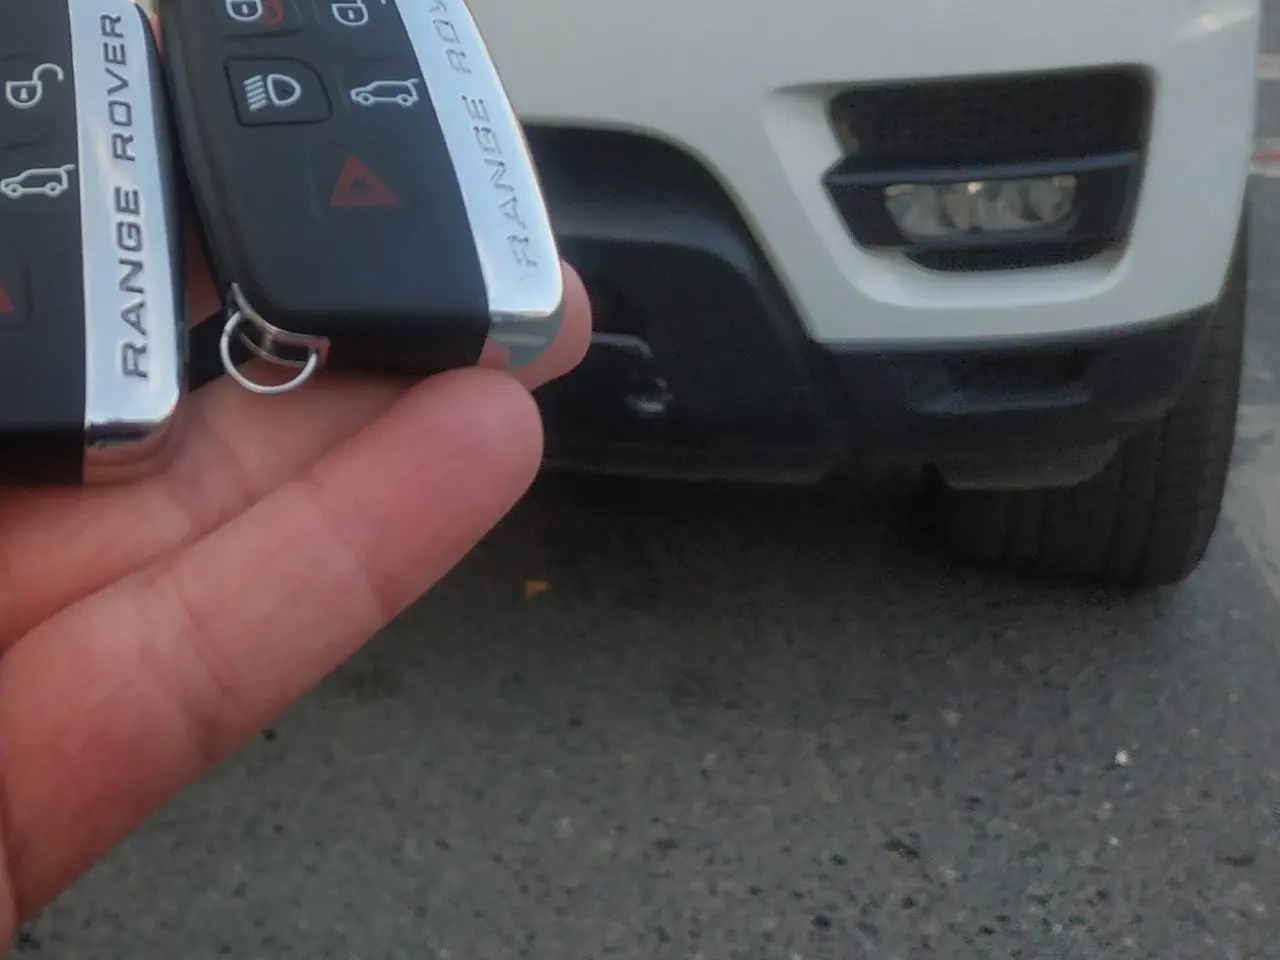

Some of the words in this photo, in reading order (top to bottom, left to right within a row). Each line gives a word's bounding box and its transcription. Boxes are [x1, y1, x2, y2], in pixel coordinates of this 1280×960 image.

[99, 13, 137, 163] ROVER
[461, 94, 538, 269] RANGE
[115, 186, 150, 381] RANGE
